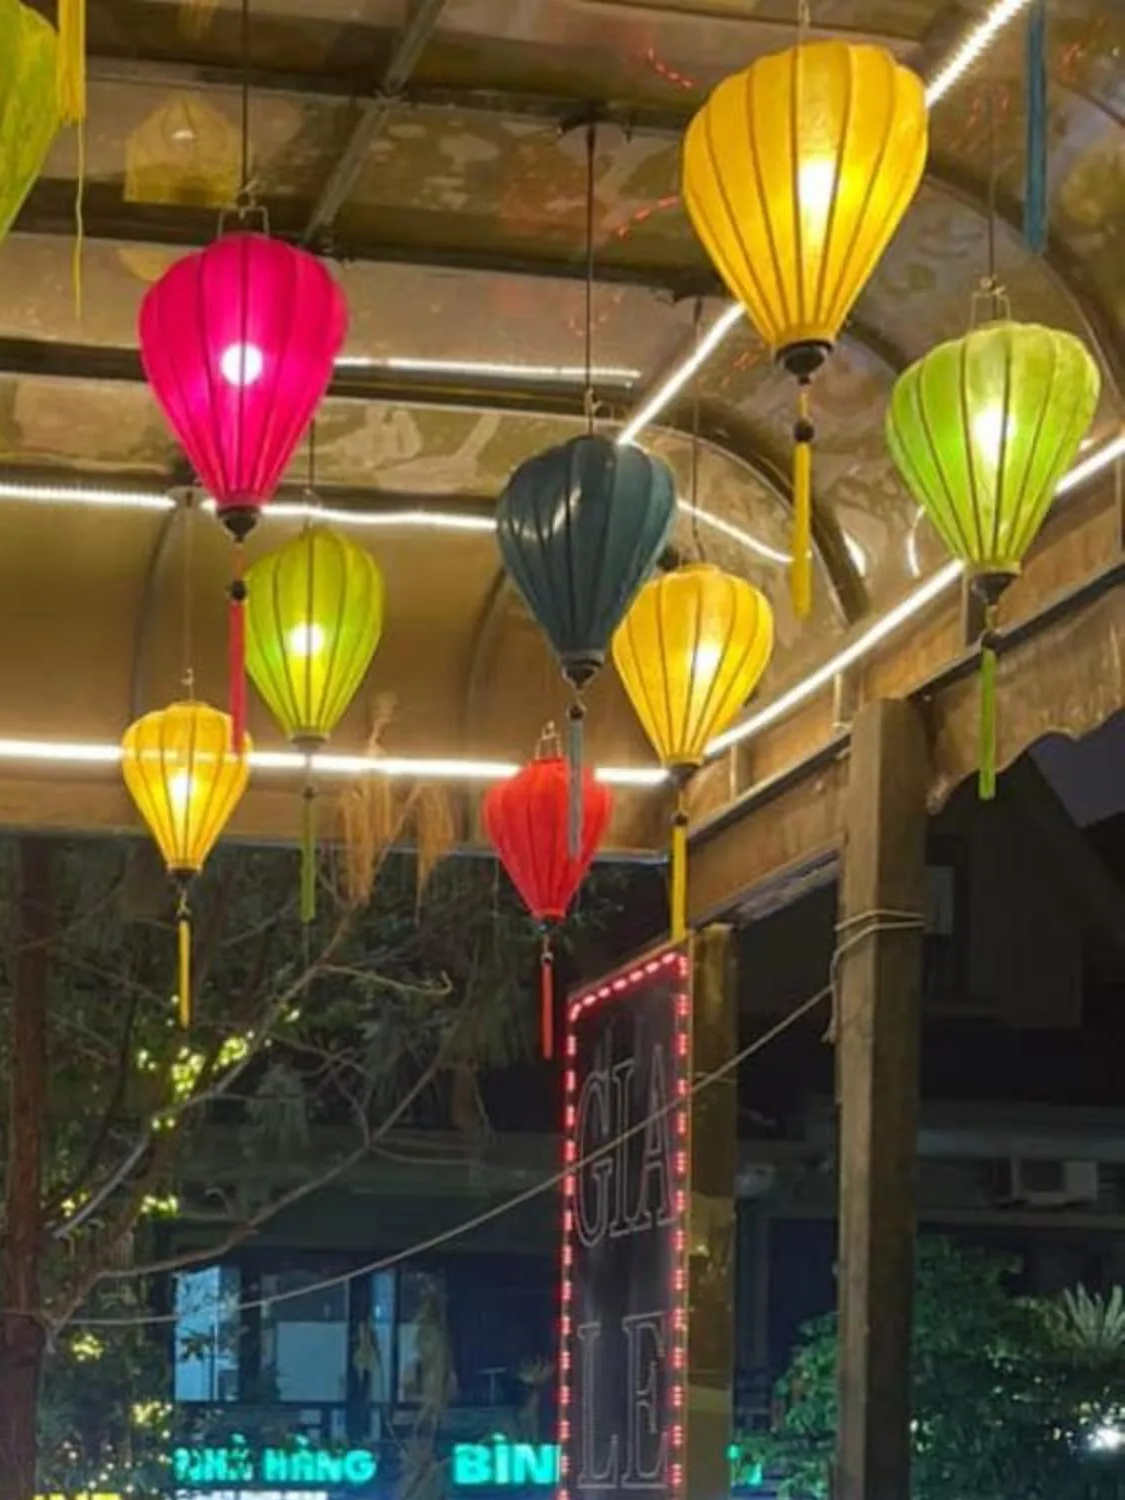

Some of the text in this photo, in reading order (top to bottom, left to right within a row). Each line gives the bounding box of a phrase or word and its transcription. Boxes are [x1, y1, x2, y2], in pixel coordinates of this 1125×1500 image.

[575, 1044, 678, 1248] GIA
[263, 1433, 376, 1483] HÀNG
[454, 1432, 562, 1484] BÌN
[576, 1311, 669, 1489] LE
